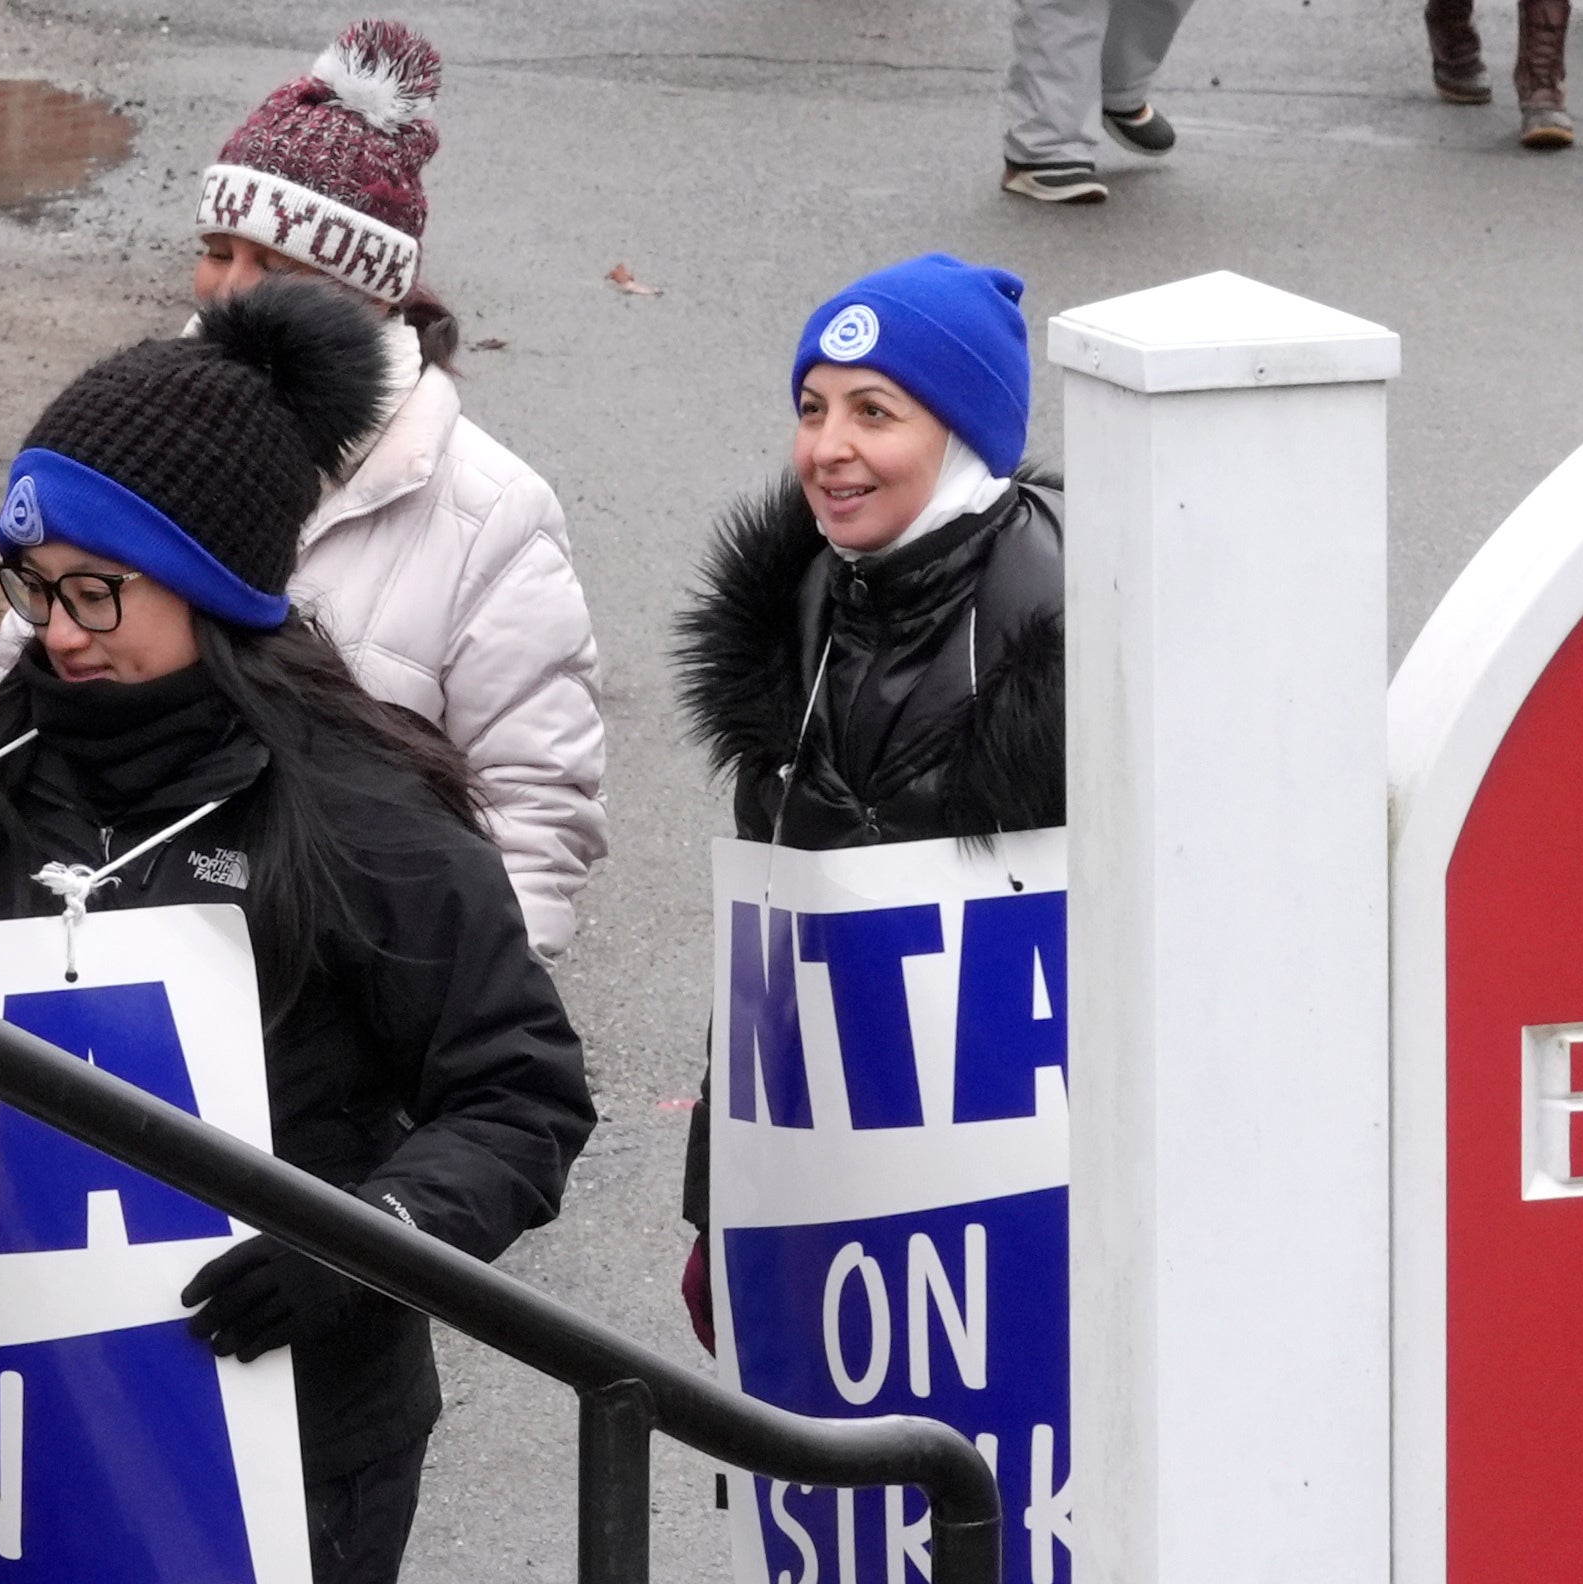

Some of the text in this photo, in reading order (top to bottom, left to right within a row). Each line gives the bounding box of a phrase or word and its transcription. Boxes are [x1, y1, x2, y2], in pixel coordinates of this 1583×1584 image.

[269, 187, 413, 298] YORK
[187, 850, 233, 872] NORTH
[193, 867, 228, 884] FACE
[215, 847, 238, 861] THE
[730, 890, 1068, 1130] NTA
[822, 1223, 987, 1406] ON
